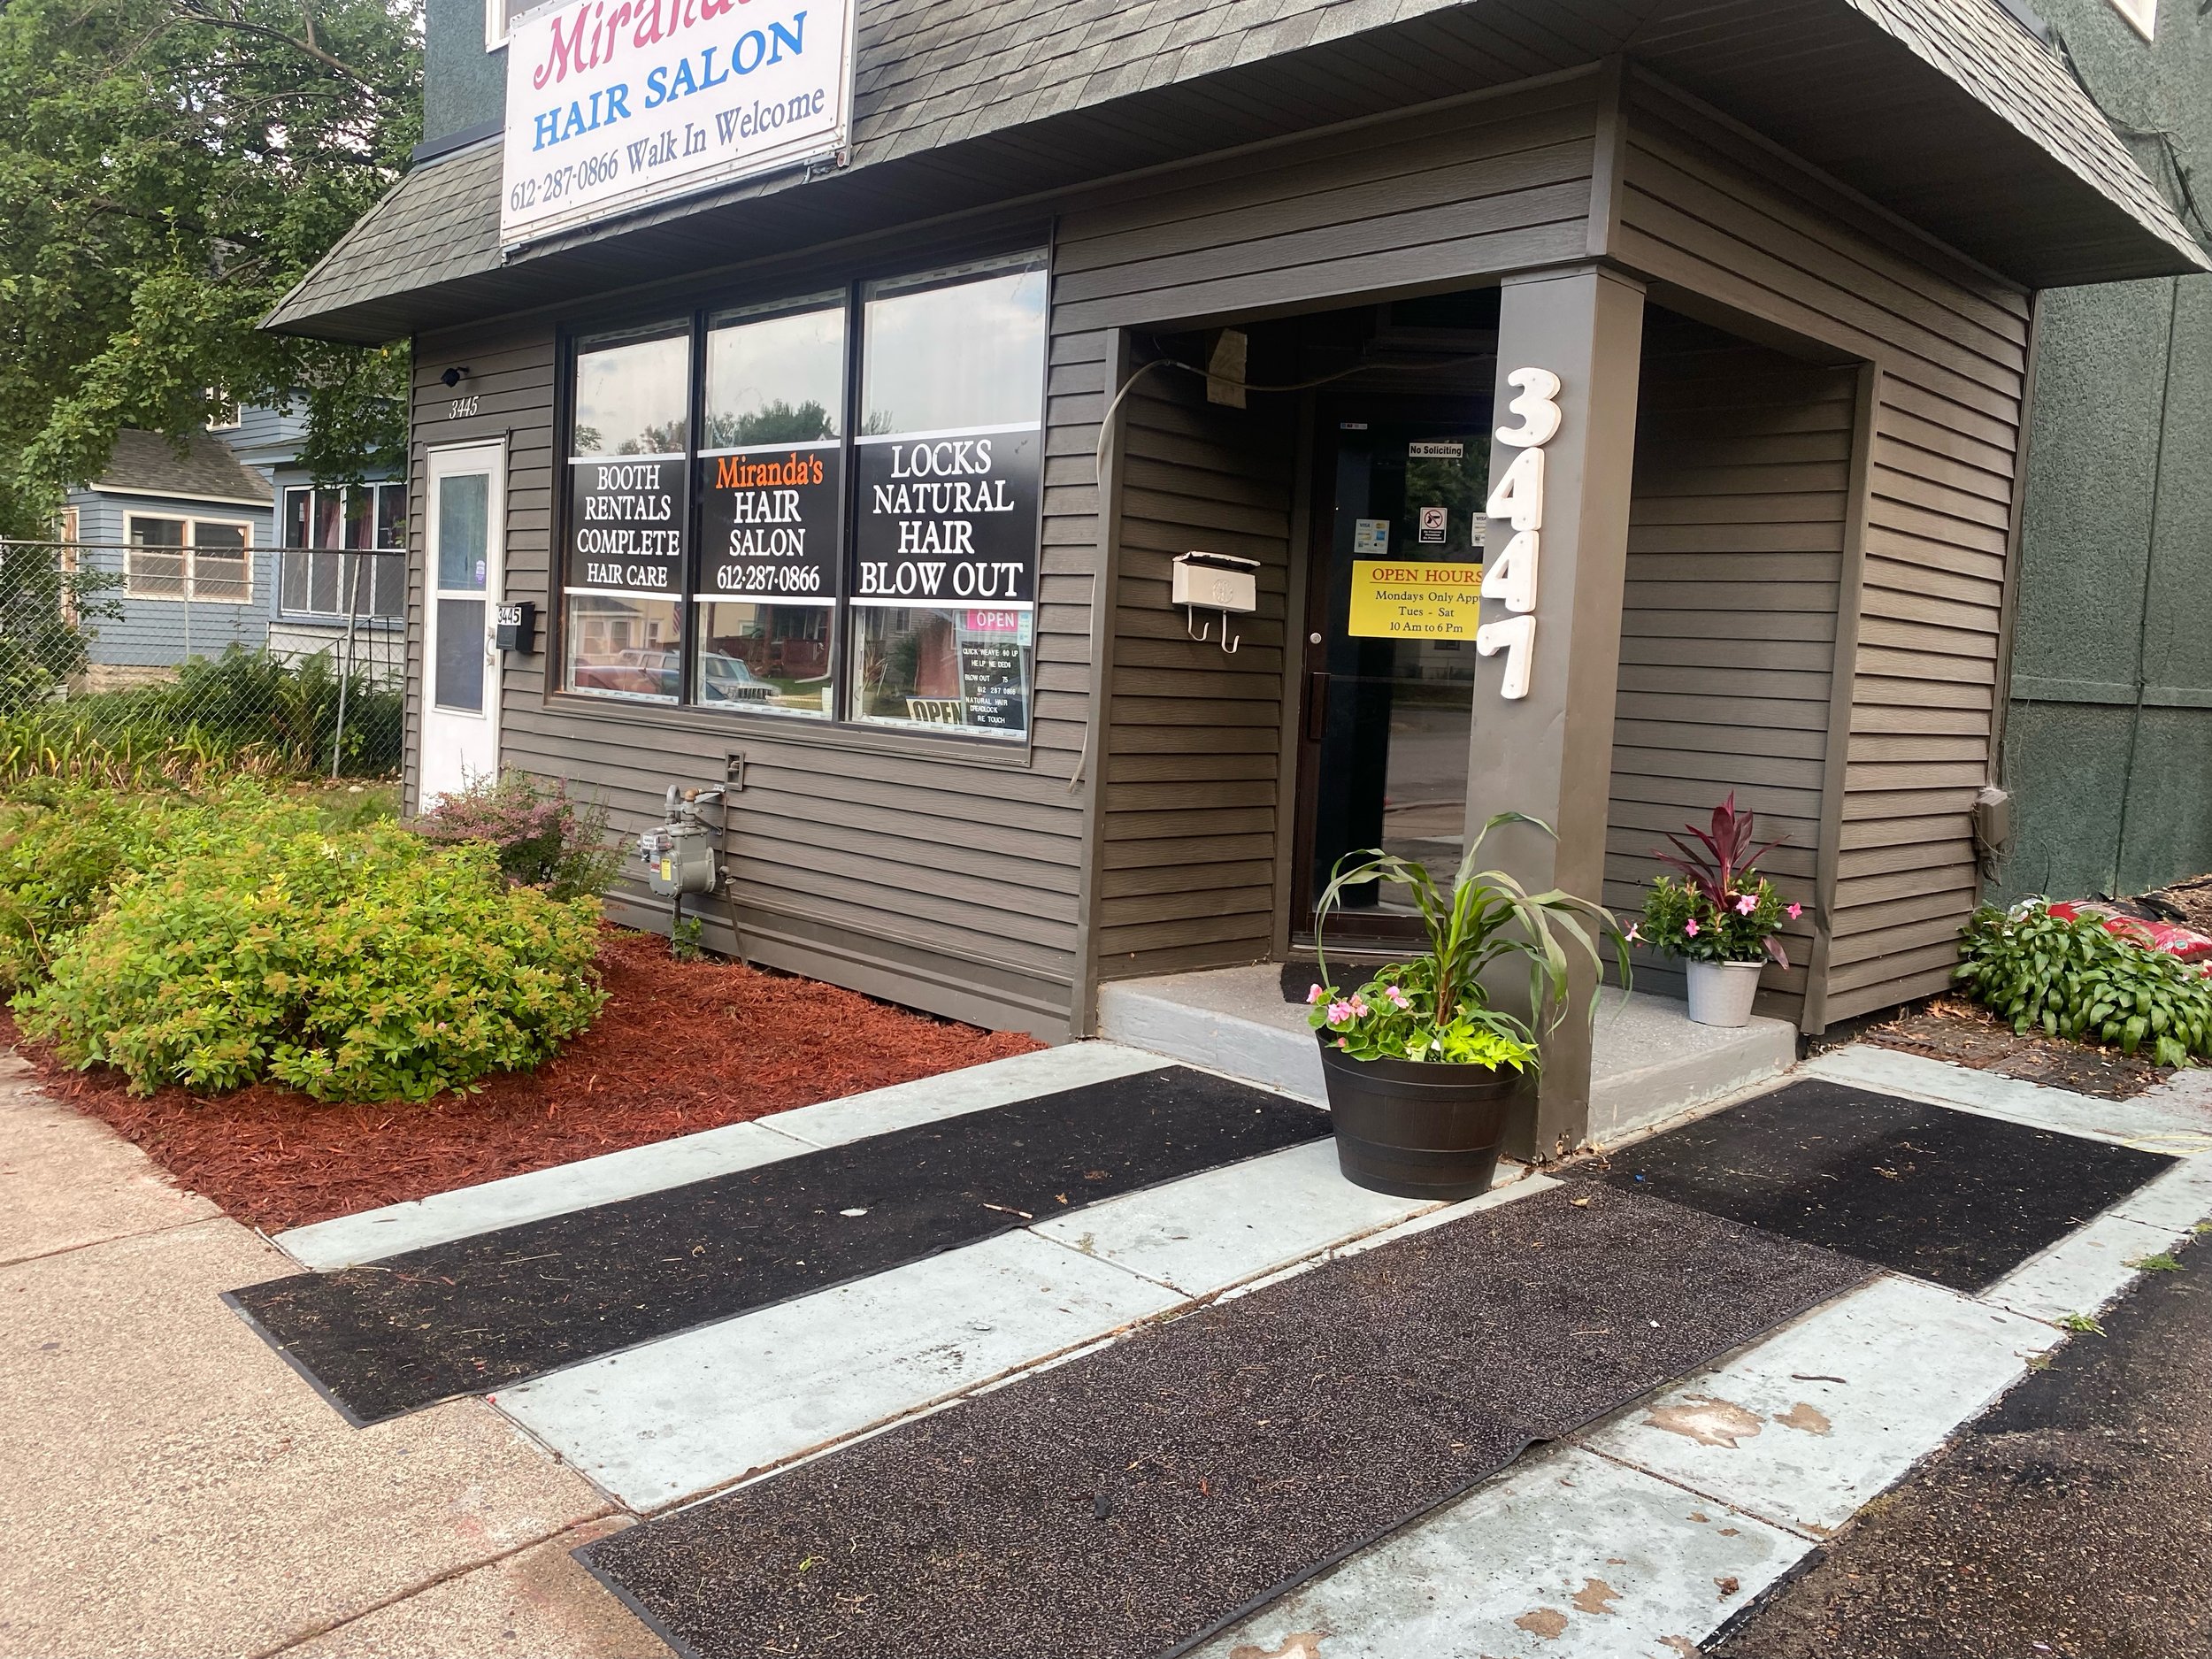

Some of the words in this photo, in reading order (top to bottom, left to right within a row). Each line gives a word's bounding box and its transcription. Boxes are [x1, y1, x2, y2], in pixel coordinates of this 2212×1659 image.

[534, 0, 750, 90] Miran
[533, 83, 631, 151] HAIR
[644, 11, 807, 110] SALON
[511, 150, 618, 212] 612-287-0866
[626, 130, 678, 174] Walk
[683, 123, 707, 158] In
[716, 88, 825, 146] Welcome
[449, 396, 479, 419] 3445
[890, 440, 992, 478] LOCKS
[1424, 446, 1462, 457] Soliciting
[596, 465, 661, 491] BOOTH
[715, 452, 824, 489] Miranda's
[584, 495, 671, 521] RENTALS
[733, 489, 802, 524] HAIR
[872, 480, 1014, 514] NATURAL
[577, 528, 680, 556] COMPLETE
[729, 528, 805, 557] SALON
[897, 520, 975, 554] HAIR
[1477, 366, 1562, 700] 3447
[587, 563, 624, 585] HAIR
[626, 565, 668, 588] CARE
[859, 561, 947, 595] BLOW
[953, 561, 1023, 596] OUT
[1372, 568, 1418, 581] OPEN
[1425, 570, 1483, 583] HOURS
[1375, 590, 1424, 603] Mondays
[1428, 592, 1454, 603] Only
[498, 608, 519, 624] 3445
[977, 611, 1015, 627] OPEN
[1398, 606, 1424, 616] Tues
[1438, 607, 1455, 617] Sat
[1390, 621, 1401, 631] 10
[1402, 622, 1422, 632] Am
[1437, 623, 1443, 632] 6
[1446, 623, 1463, 633] Pm
[912, 701, 963, 725] OPEN
